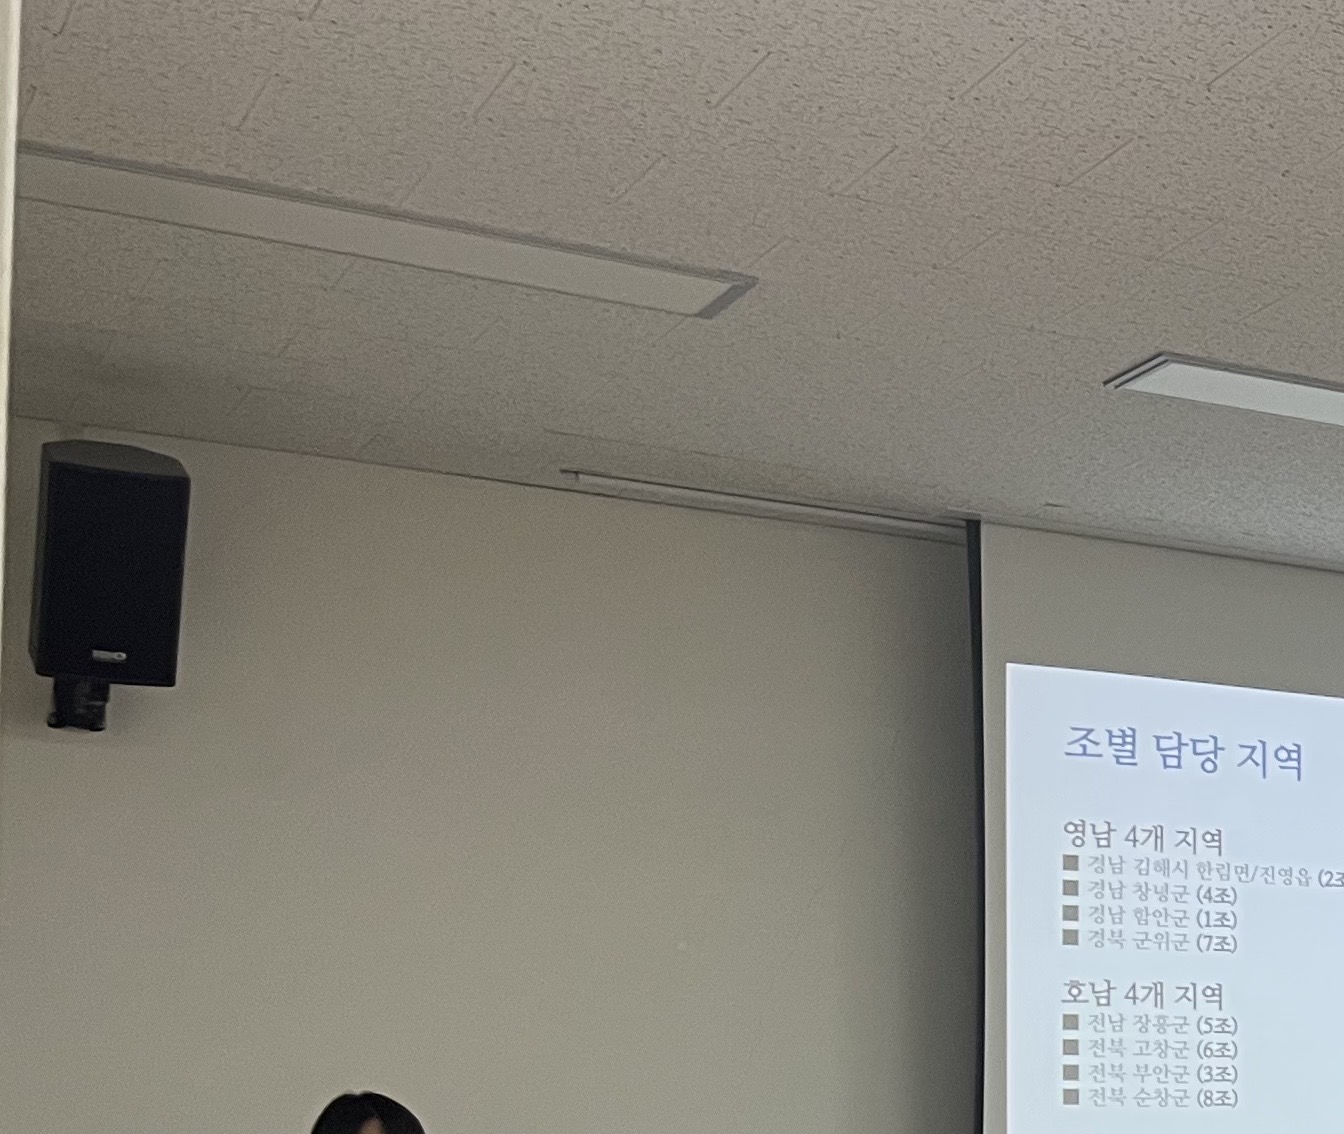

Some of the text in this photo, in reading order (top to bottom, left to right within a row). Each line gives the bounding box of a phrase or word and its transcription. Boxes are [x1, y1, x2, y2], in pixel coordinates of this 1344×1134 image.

[1063, 725, 1304, 782] 조별 담당 지역
[1063, 818, 1225, 857] 영남 4개 지역
[1087, 853, 1127, 876] 경남
[1133, 856, 1189, 881] 김해시
[1196, 860, 1313, 888] 한림면/진영읍
[1087, 878, 1239, 907] 경남 창녕군 (4조)
[1087, 903, 1239, 931] 경남 함안군 (1조)
[1087, 927, 1239, 955] 경북 군위군 (7조)
[1061, 978, 1225, 1012] 호남 4개 지역
[1087, 1012, 1239, 1037] 전남 장흥군 (5조)
[1087, 1037, 1239, 1061] 전북 고창군 (6조)
[1087, 1062, 1239, 1086] 전북 부안군 (3조)
[1087, 1086, 1239, 1110] 전북 순창군 (8조)
